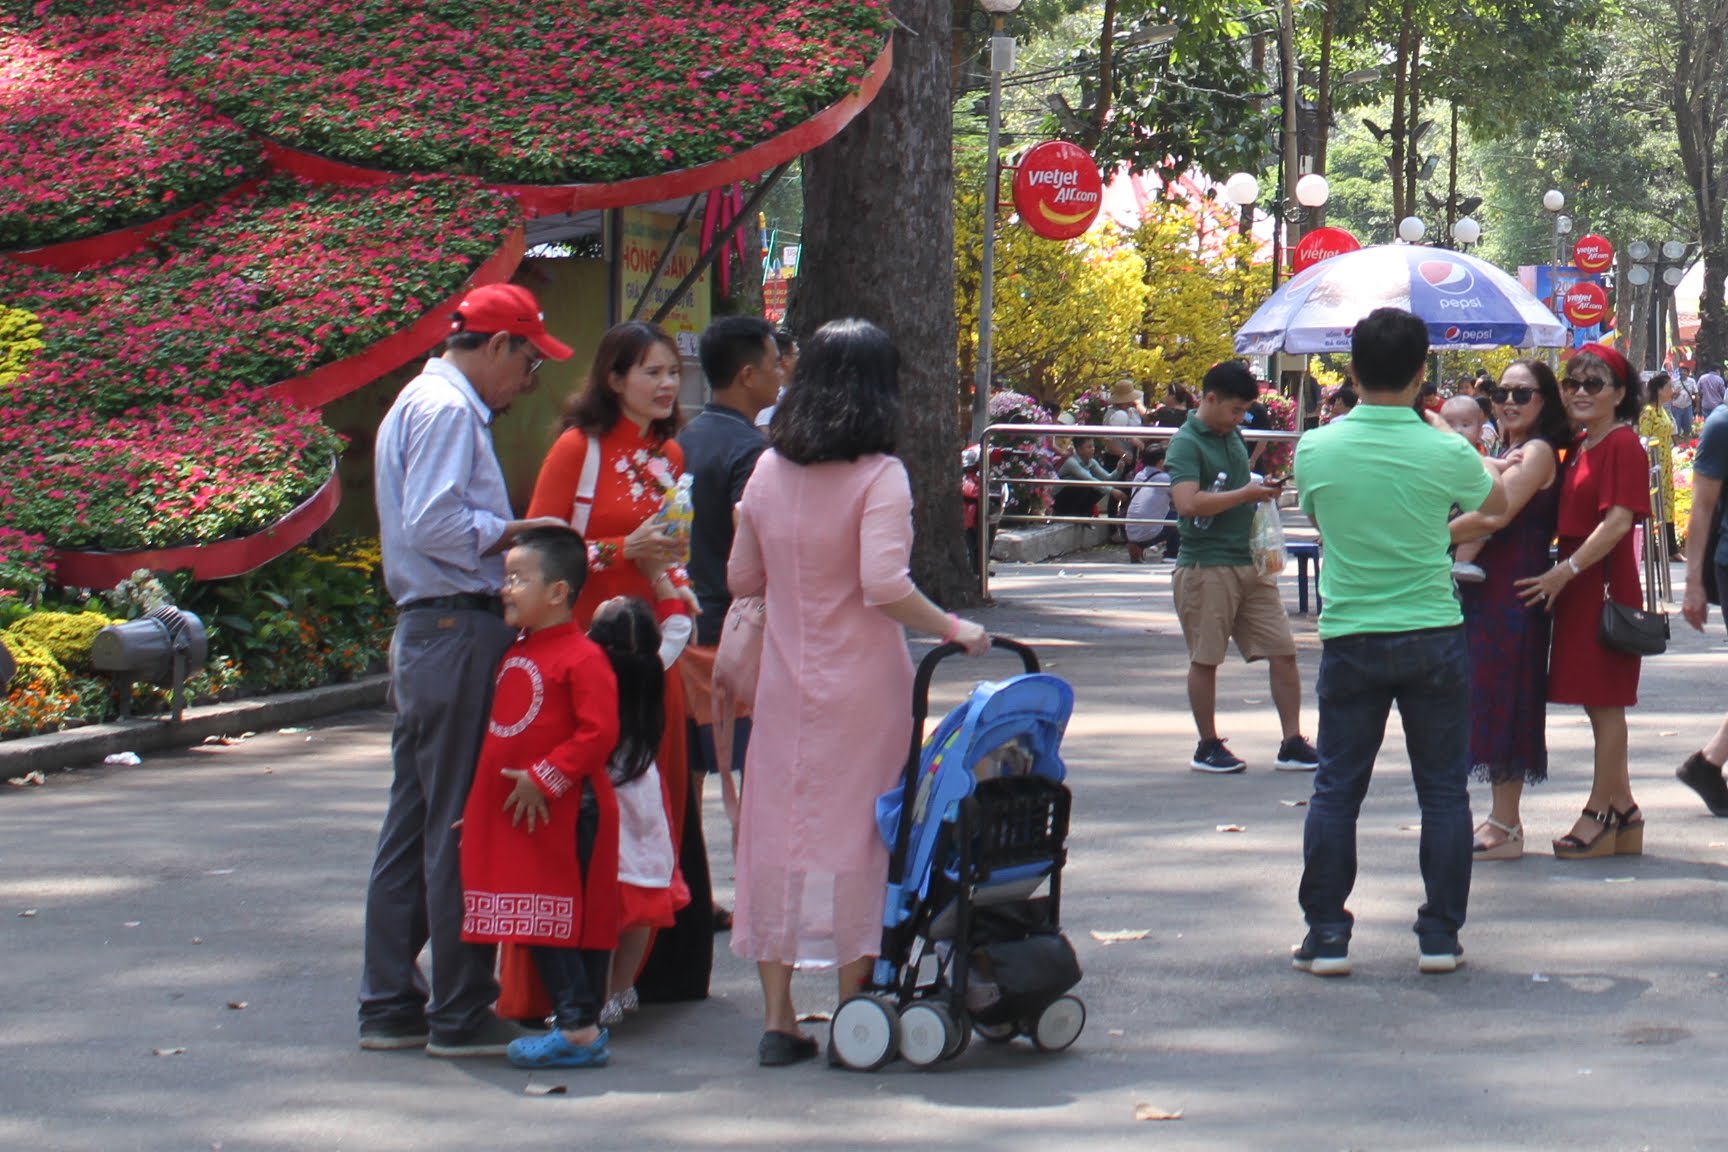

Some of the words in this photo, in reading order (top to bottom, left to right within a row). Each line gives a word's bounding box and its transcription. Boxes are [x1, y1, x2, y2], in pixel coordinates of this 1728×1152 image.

[1054, 188, 1097, 203] Air.com
[1440, 297, 1482, 309] pepsi
[1462, 329, 1493, 341] pepsi
